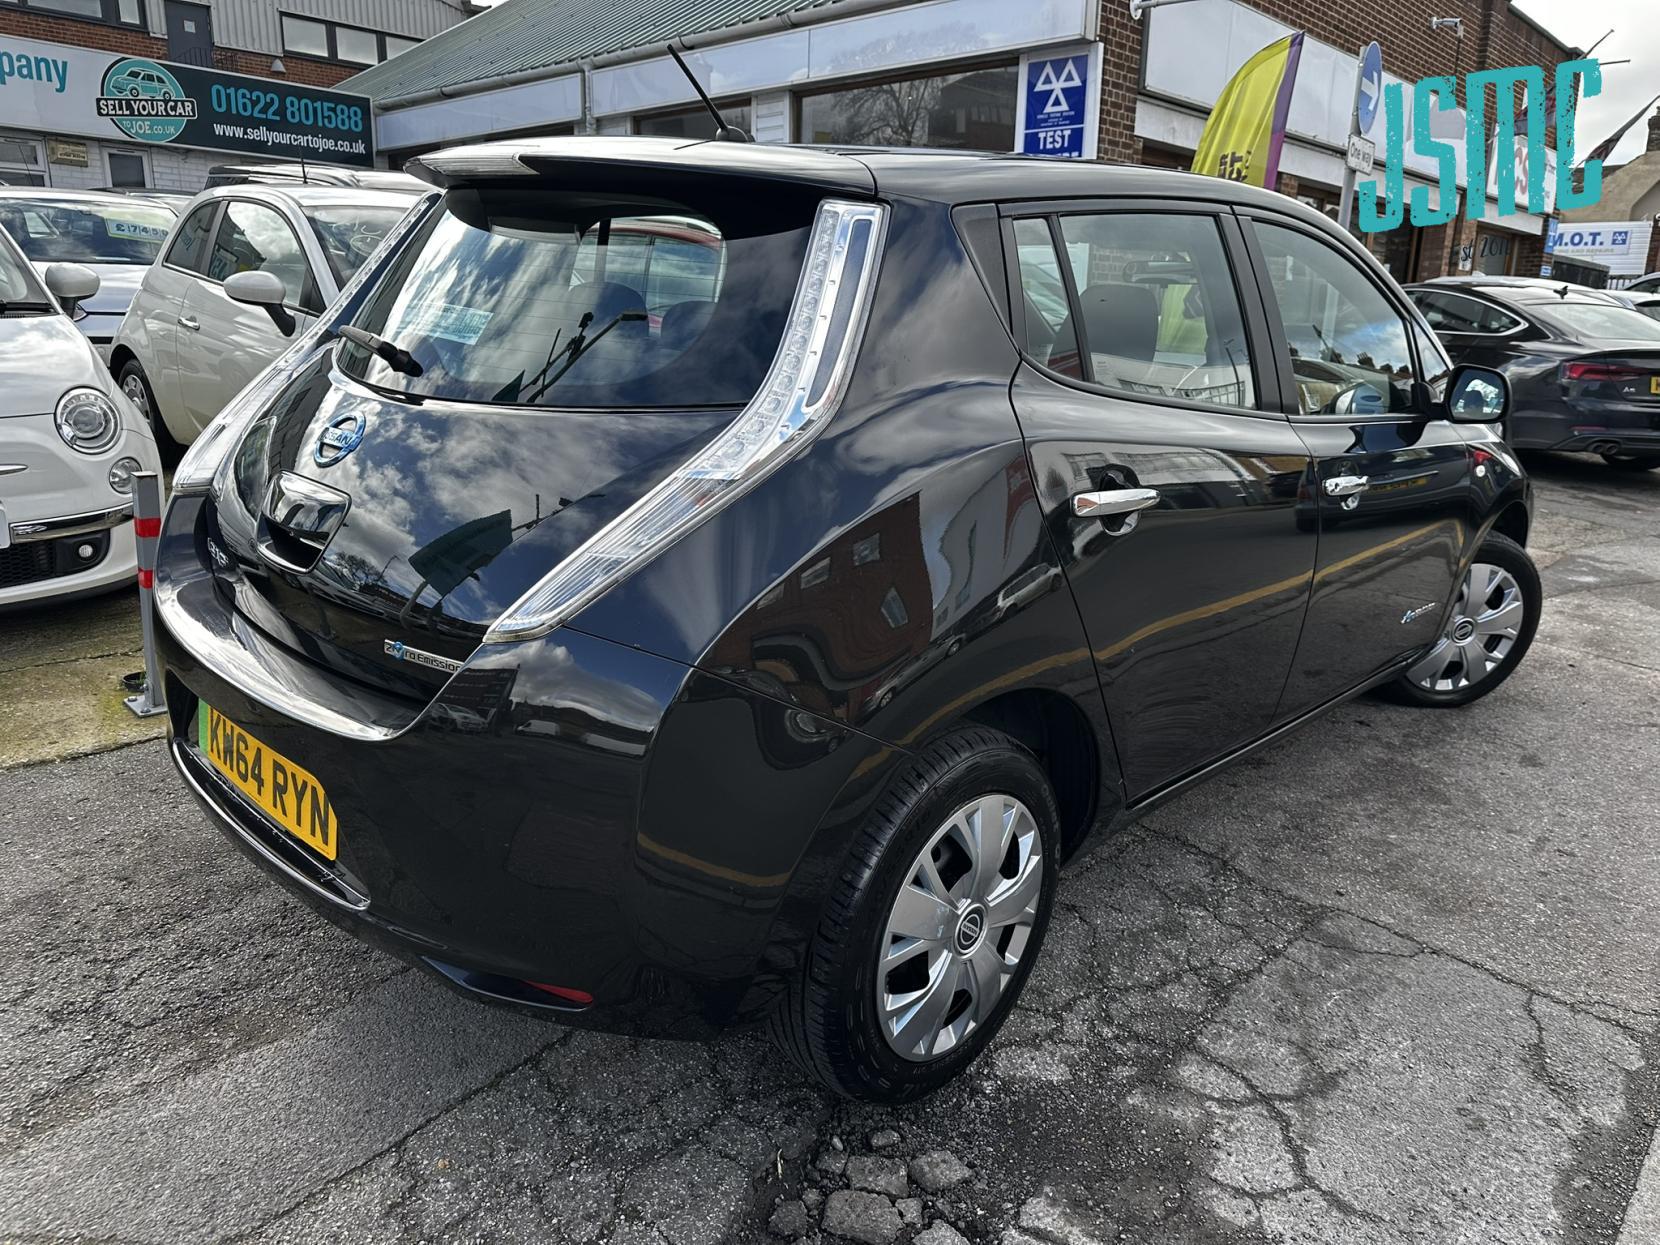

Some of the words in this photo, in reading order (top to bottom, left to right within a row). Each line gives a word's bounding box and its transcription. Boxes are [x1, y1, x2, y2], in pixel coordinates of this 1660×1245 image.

[0, 51, 68, 93] pany
[99, 99, 130, 115] SELL
[132, 100, 166, 115] YOUR
[167, 101, 194, 117] CAR
[211, 84, 281, 121] 01622
[285, 96, 363, 132] 801588
[213, 123, 366, 155] www.sellyourcartojoe.co.uk
[1038, 129, 1072, 150] TEST
[1350, 141, 1361, 160] One
[1362, 150, 1372, 168] way
[384, 642, 416, 660] Zro
[417, 653, 460, 672] Emission
[210, 707, 264, 797] KW64
[272, 758, 330, 847] RYN
